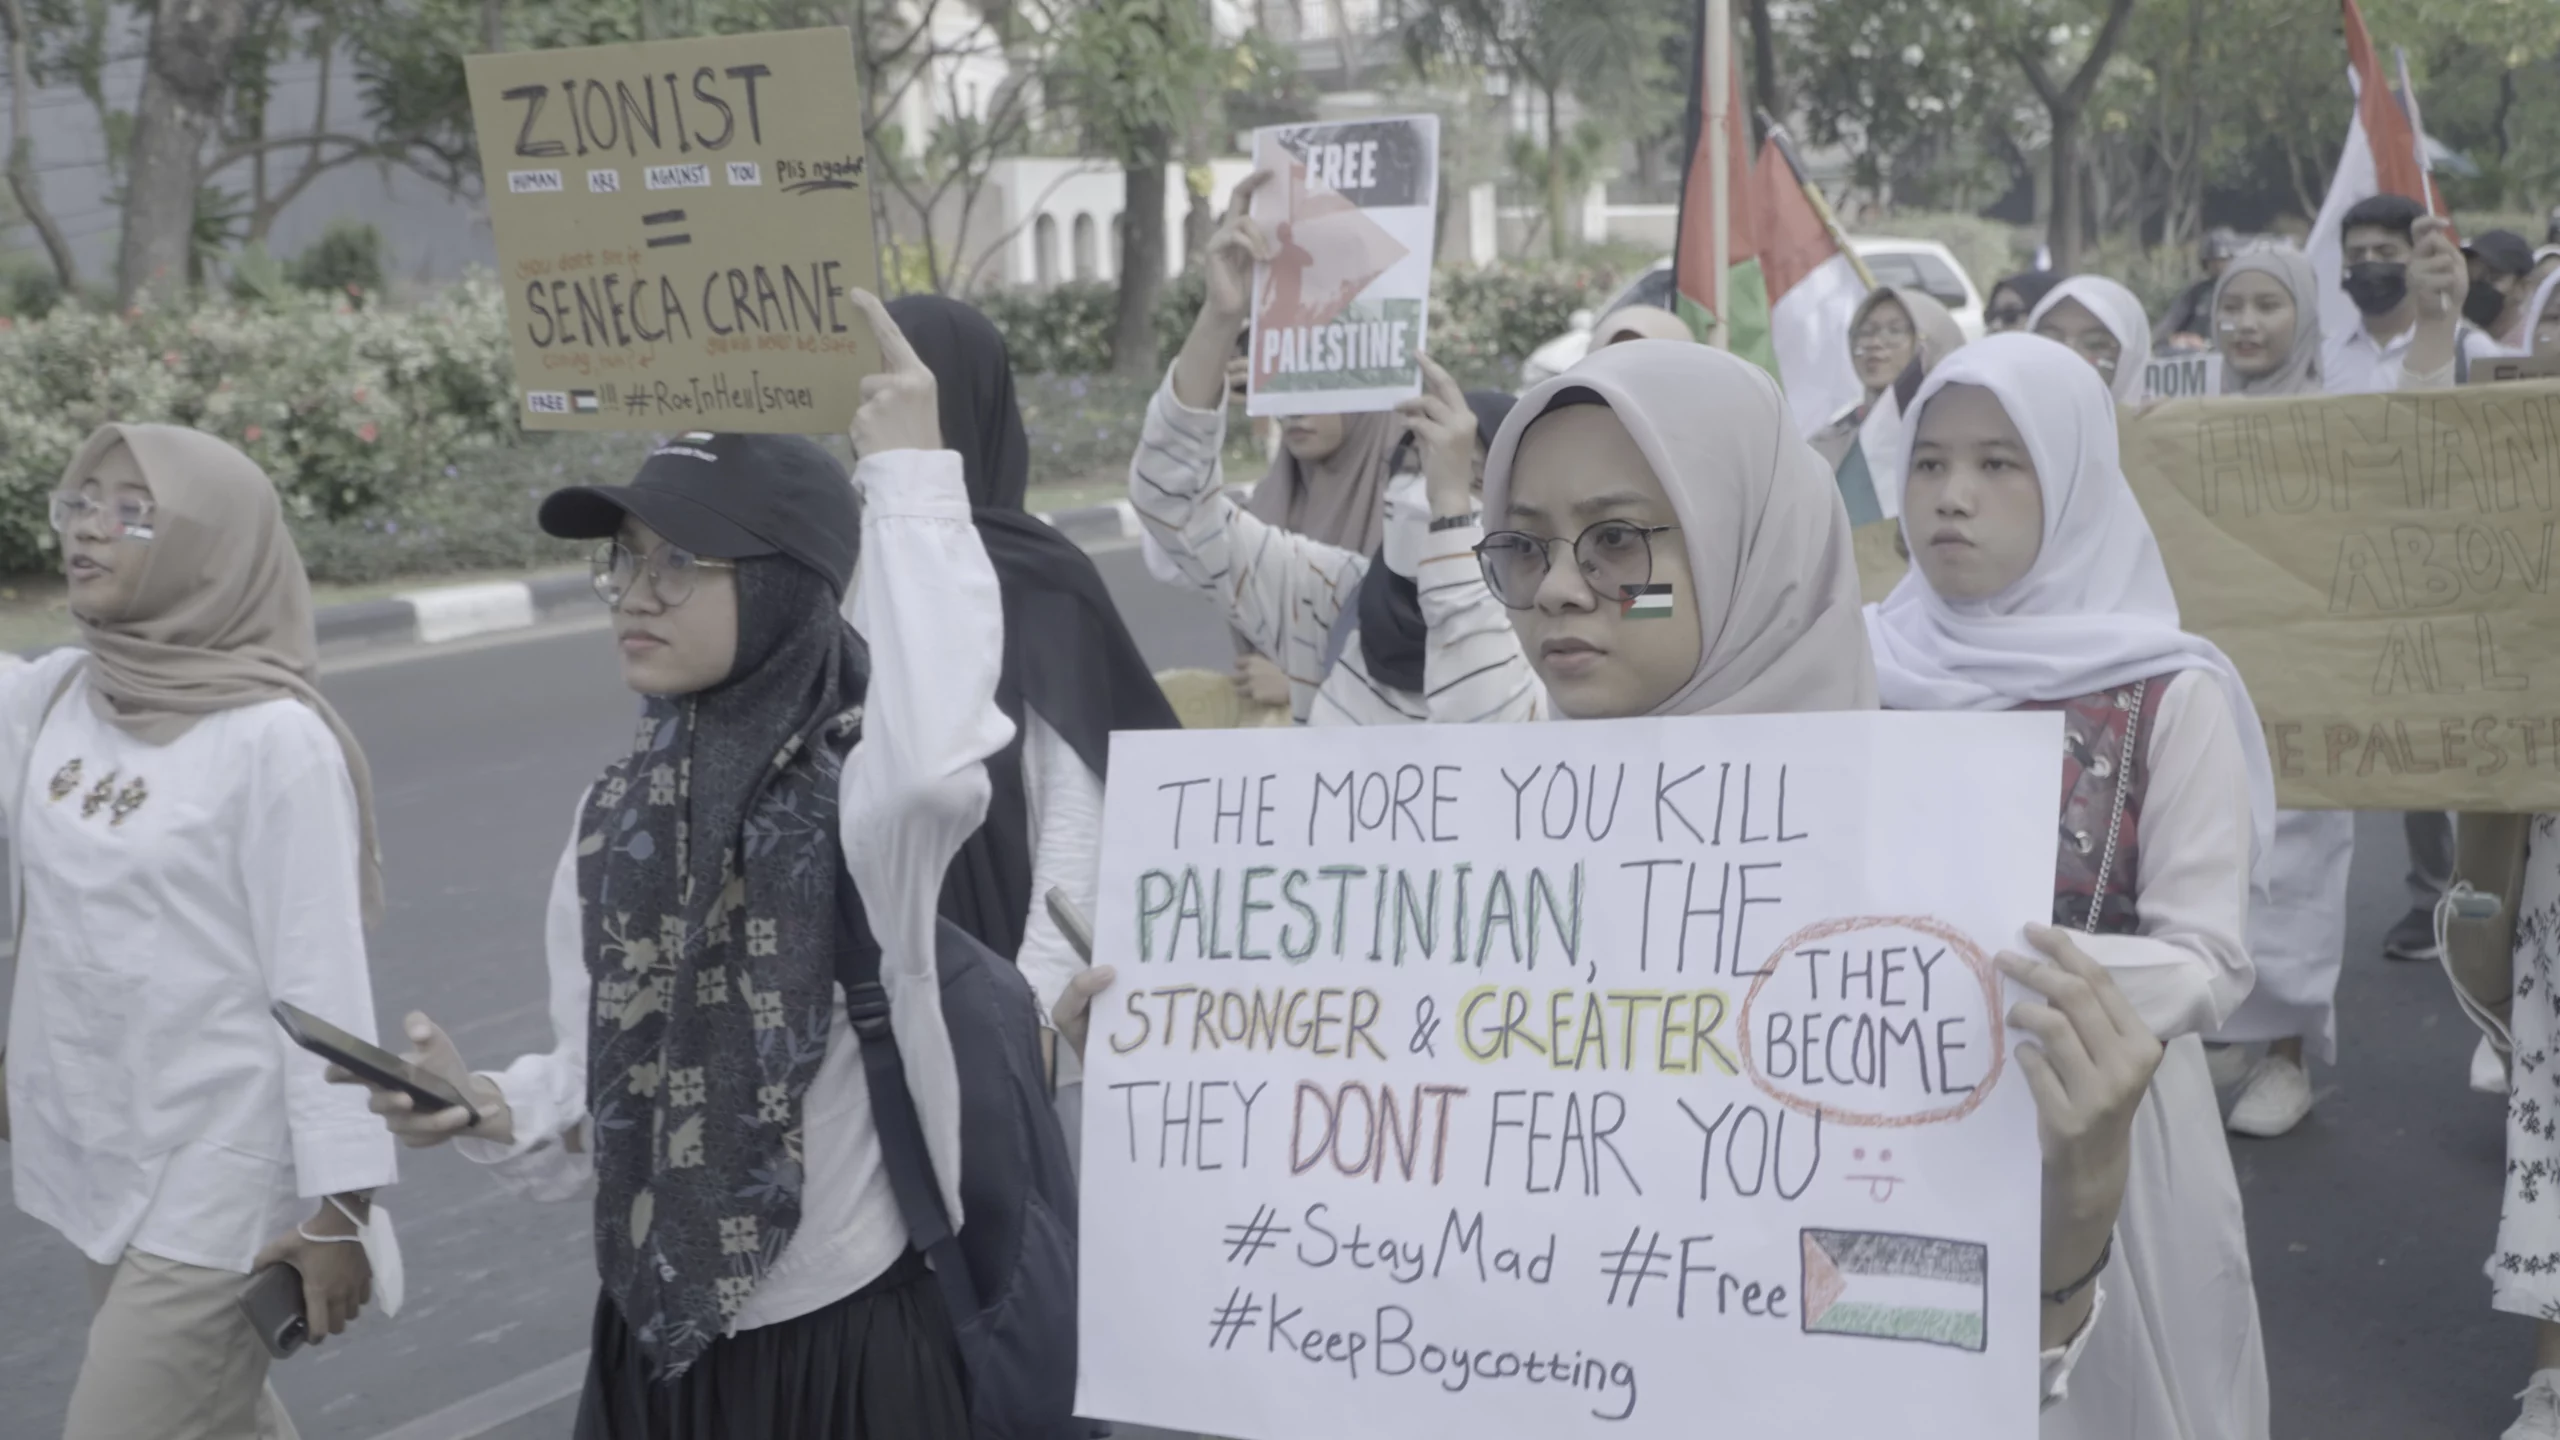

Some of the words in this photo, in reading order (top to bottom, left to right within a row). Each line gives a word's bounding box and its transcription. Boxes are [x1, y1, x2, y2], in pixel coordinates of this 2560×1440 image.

[501, 63, 772, 158] ZIONIST
[512, 173, 558, 191] HUMAN
[650, 166, 708, 186] AGAINST
[730, 163, 757, 181] YOU
[1305, 141, 1378, 190] FREE
[526, 272, 693, 349] SENECA
[703, 260, 848, 336] CRANE
[1262, 319, 1408, 374] PALESTINE
[531, 396, 565, 411] FREE
[2372, 613, 2529, 696] ALL
[1158, 774, 1275, 848] THE
[1308, 766, 1462, 846] MORE
[1500, 762, 1625, 842] YOU
[1654, 762, 1810, 846] KILL
[1136, 860, 1598, 984] PALESTINIAN,
[1620, 860, 1783, 978] THE
[1796, 946, 1948, 1012] THEY
[1110, 988, 1385, 1056] STRONGER
[1408, 996, 1440, 1054] &
[1460, 986, 1741, 1074] GREATER
[1766, 1013, 1978, 1095] BECOME
[1109, 1081, 1268, 1172] THEY
[1289, 1084, 1470, 1186] DONT
[1484, 1089, 1644, 1196] FEAR
[1677, 1099, 1823, 1202] YOU
[1222, 1203, 1556, 1285] #StayMad
[1600, 1226, 1791, 1320] #Free
[1208, 1286, 1640, 1421] #KeepBoycotting
